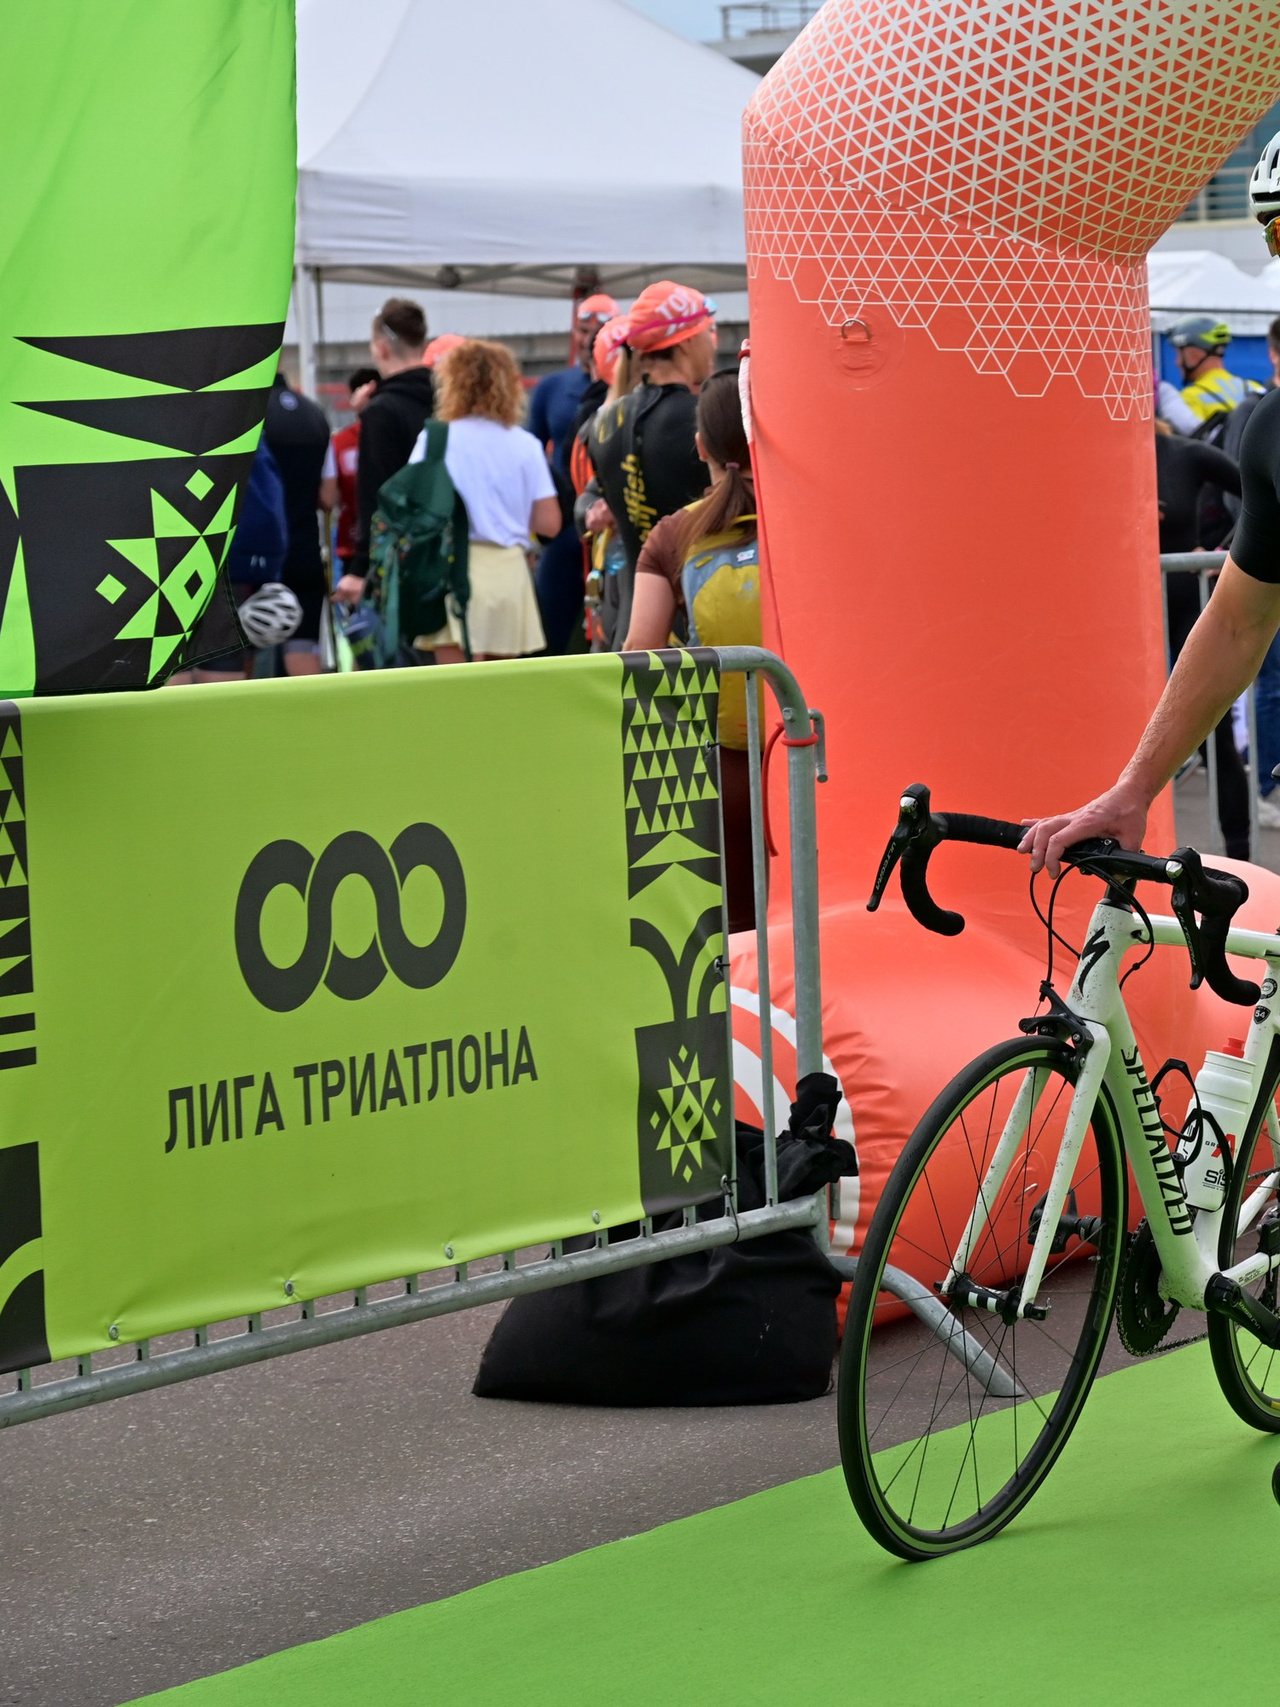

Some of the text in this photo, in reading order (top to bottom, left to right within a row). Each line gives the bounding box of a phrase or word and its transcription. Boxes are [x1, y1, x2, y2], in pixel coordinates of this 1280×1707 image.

[165, 1025, 539, 1154] ЛИГА ТРИАТЛОНА
[1121, 1045, 1194, 1236] SPECIALIZED
